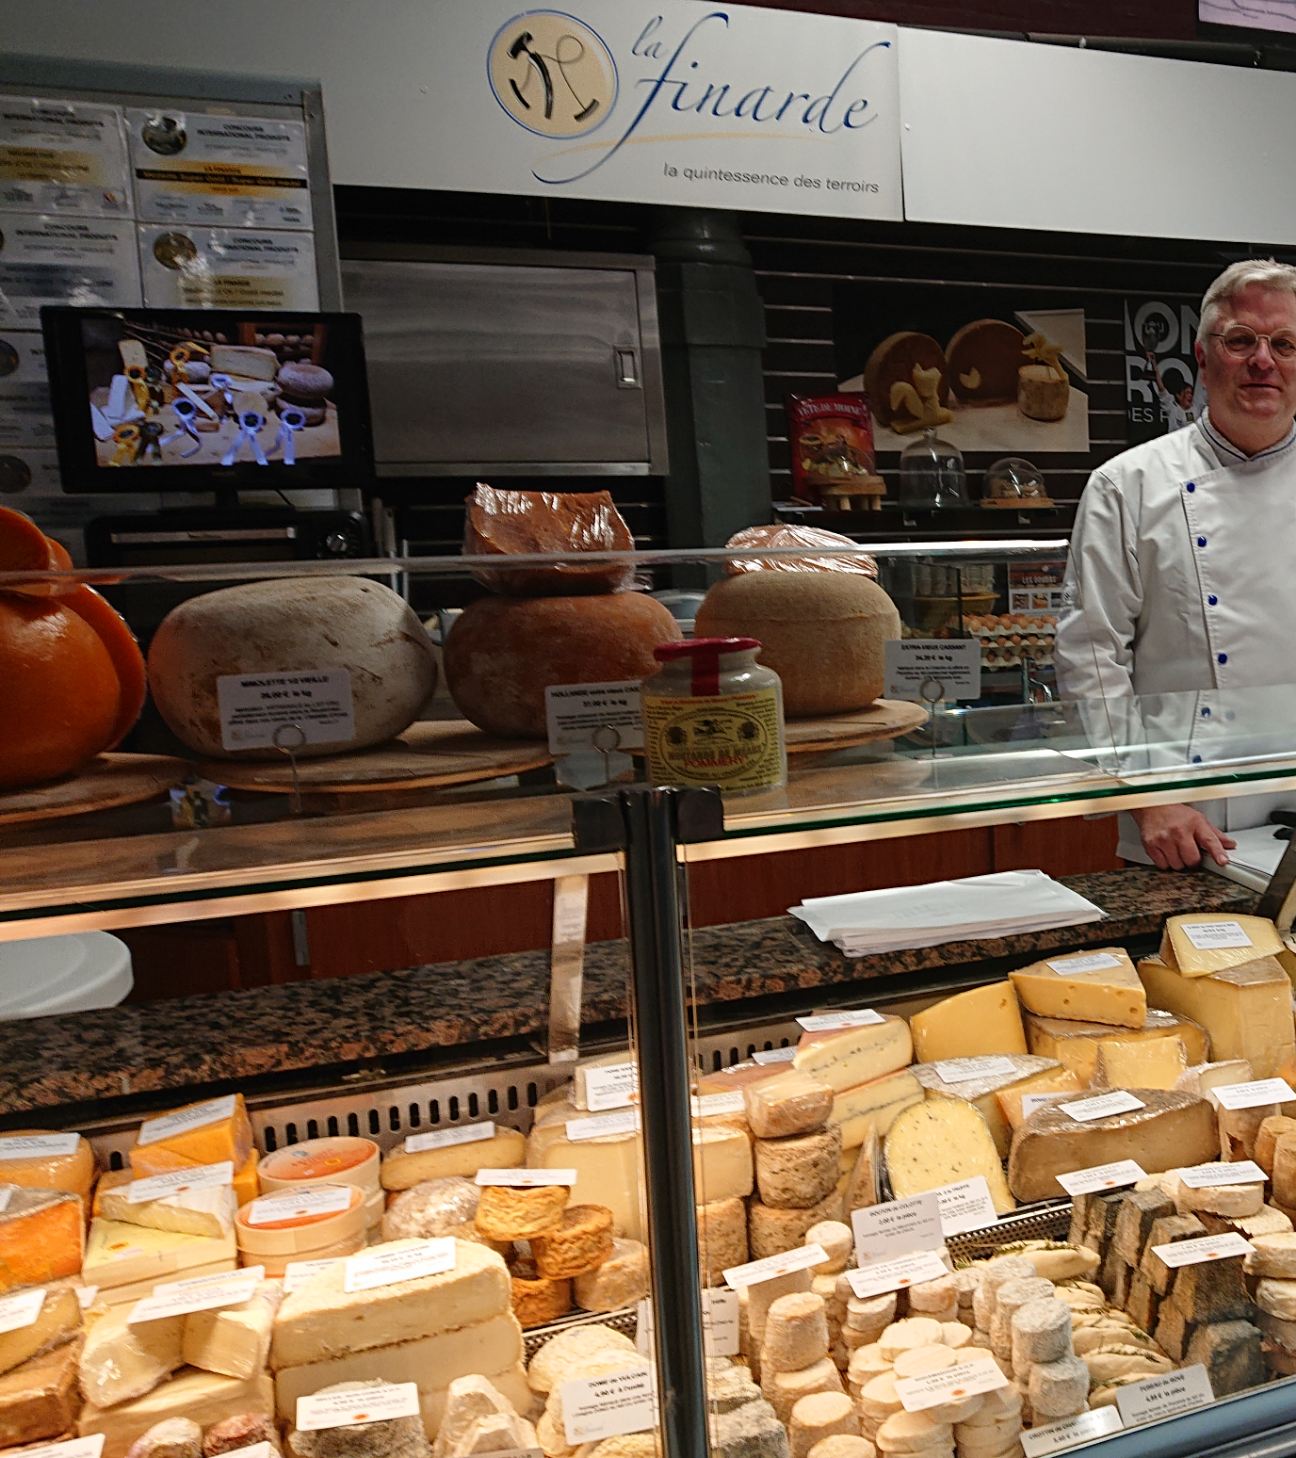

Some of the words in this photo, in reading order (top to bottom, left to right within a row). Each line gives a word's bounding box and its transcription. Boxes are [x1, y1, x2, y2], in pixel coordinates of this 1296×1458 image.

[632, 15, 663, 59] la
[532, 12, 891, 184] finarde
[664, 162, 678, 178] la
[683, 165, 790, 187] quintessence
[793, 174, 822, 190] des
[826, 178, 880, 194] terroirs
